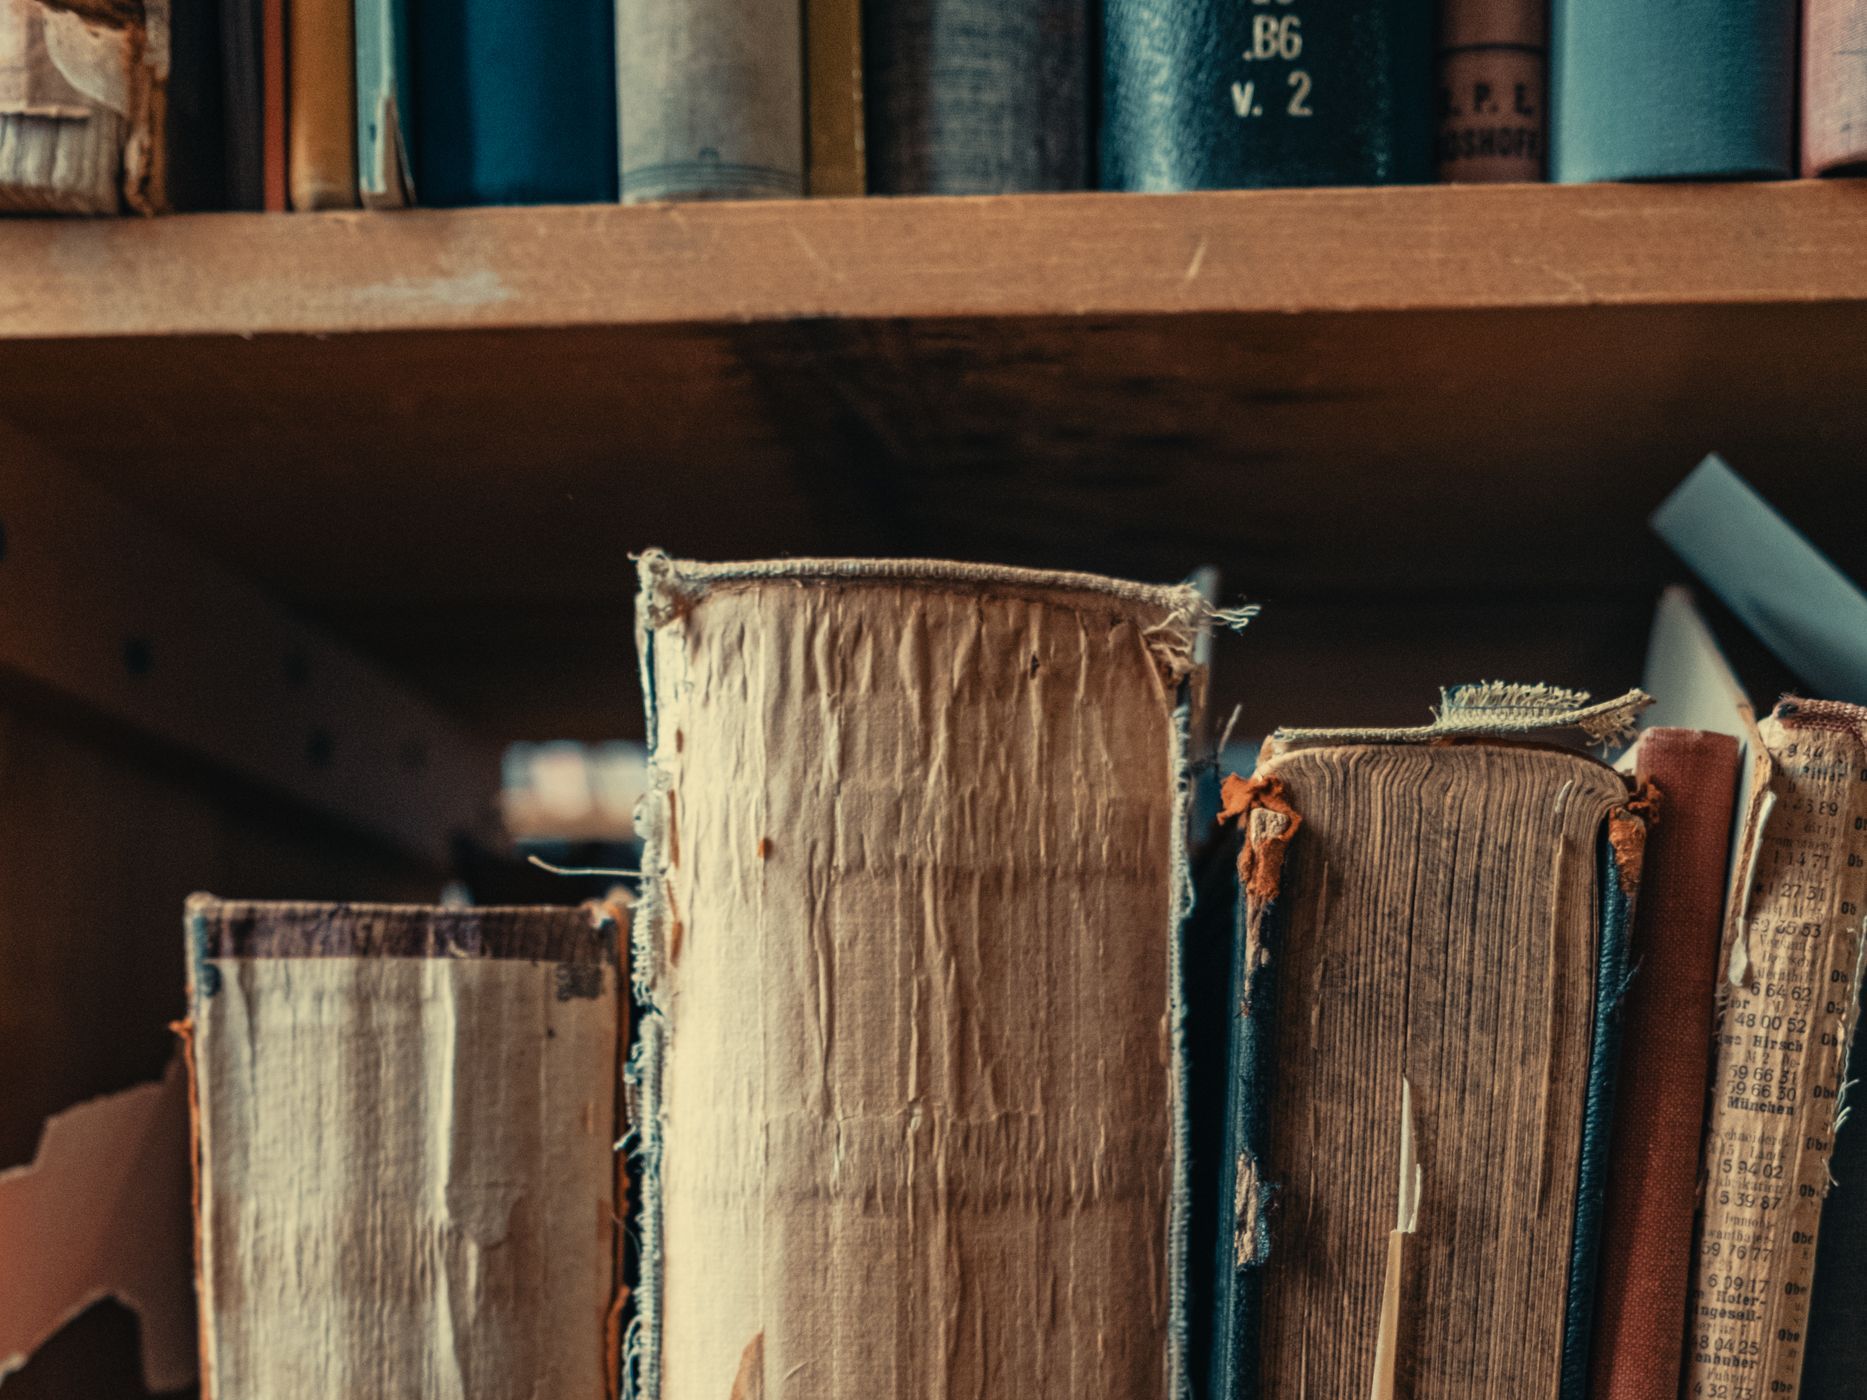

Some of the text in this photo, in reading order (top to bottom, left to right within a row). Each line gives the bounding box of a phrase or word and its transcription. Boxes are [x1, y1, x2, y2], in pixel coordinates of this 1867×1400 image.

[1242, 15, 1303, 60] .B6
[1231, 71, 1313, 117] v. 2
[1781, 883, 1801, 898] 27
[1801, 922, 1822, 938] 53
[1751, 981, 1812, 1002] 6 64 62
[1735, 1012, 1807, 1034] 48 00 52
[1753, 1034, 1804, 1053] Hirsch
[1753, 1067, 1774, 1083] 66
[1751, 1083, 1771, 1098] 66
[1727, 1096, 1796, 1116] München
[1722, 1159, 1732, 1173] 5
[1763, 1164, 1784, 1179] 02
[1719, 1190, 1729, 1205] 5
[1751, 1247, 1773, 1263] 77
[1708, 1273, 1771, 1294] 6 09 17
[1715, 1337, 1735, 1353] 04
[1738, 1340, 1759, 1356] 25
[1693, 1381, 1702, 1394] 4
[1707, 1383, 1727, 1399] 32
